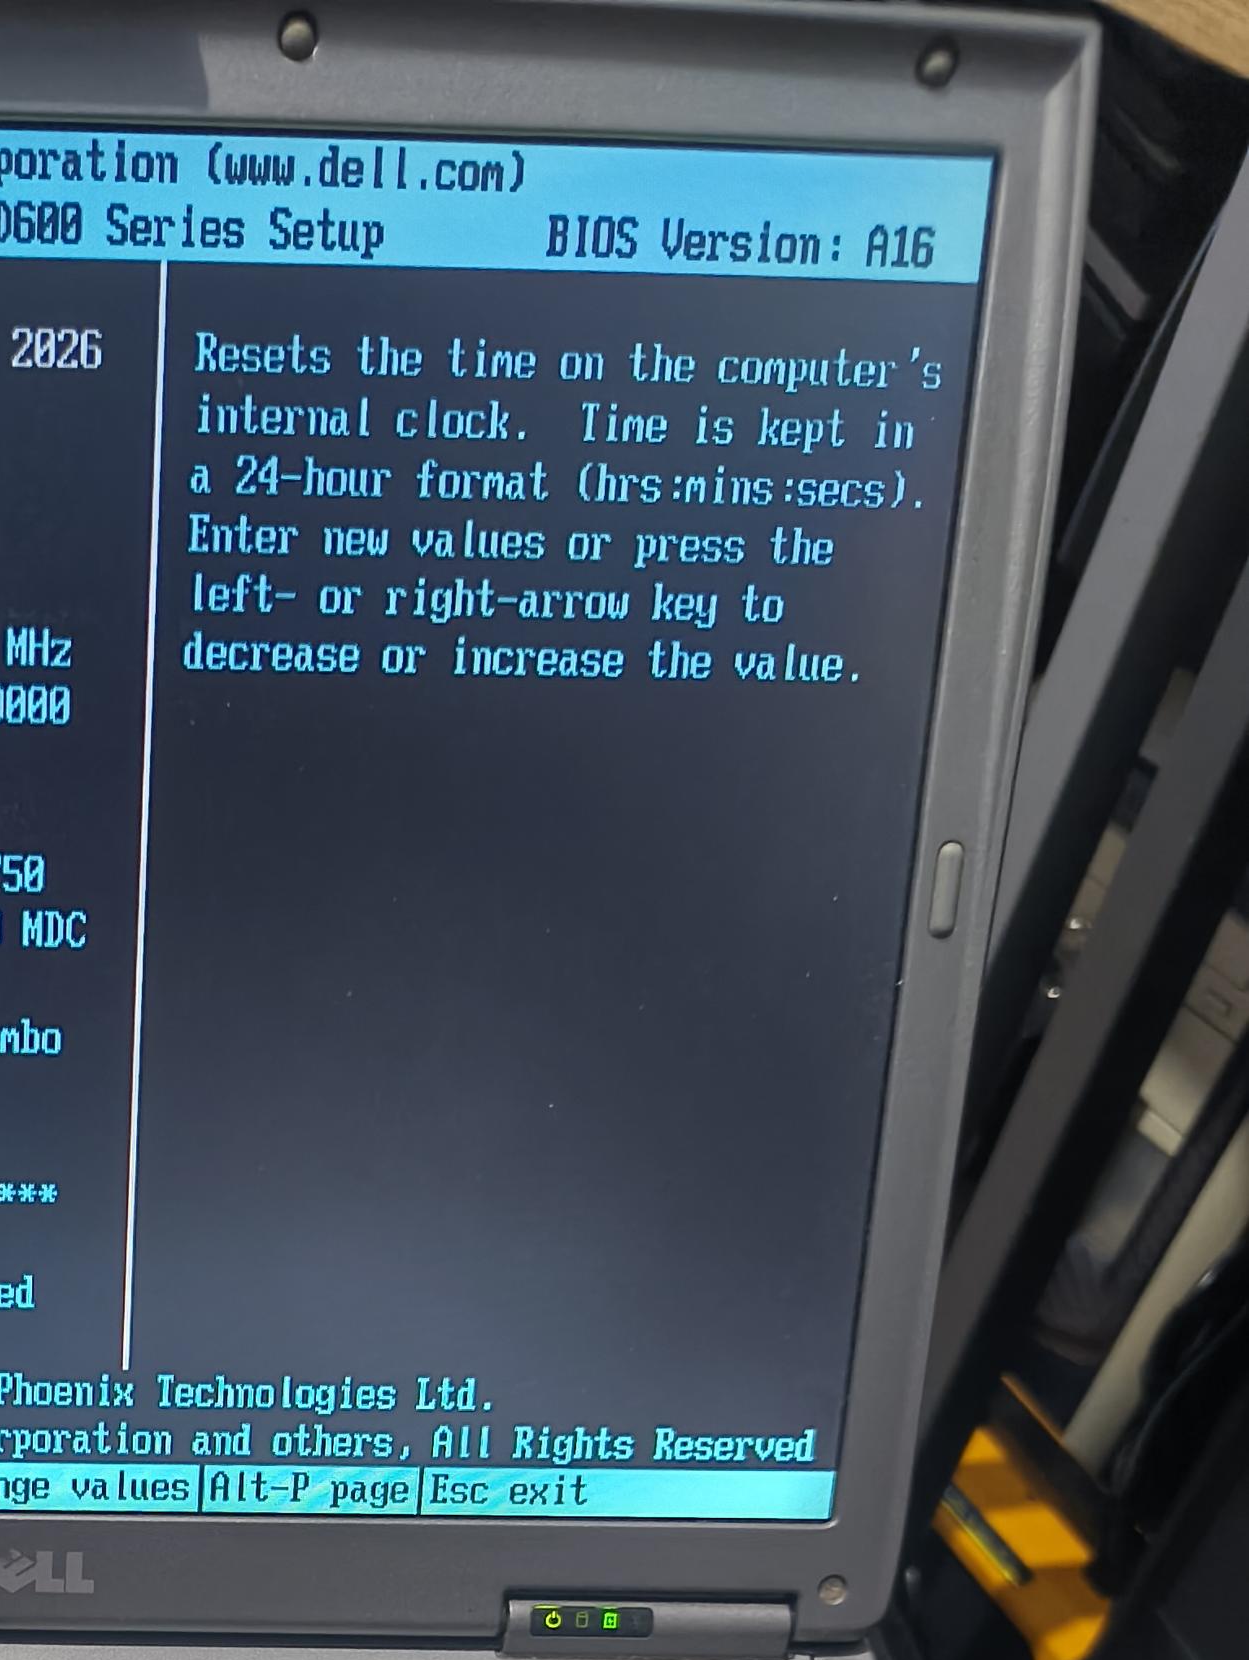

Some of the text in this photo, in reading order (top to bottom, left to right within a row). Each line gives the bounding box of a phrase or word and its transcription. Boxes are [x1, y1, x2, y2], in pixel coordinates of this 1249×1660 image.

[208, 142, 524, 192] (www.dell.com)
[107, 203, 244, 248] Series
[270, 207, 383, 259] Setup
[546, 215, 935, 268] BIOS Version: A16
[12, 328, 102, 368] 2026
[195, 332, 941, 392] Resets the time on the computer's
[198, 394, 913, 453] internal clock. Time is kept in
[191, 455, 921, 508] a 24-hour format (hrs:mins:secs).
[189, 514, 833, 568] Enter new values or press the
[7, 628, 71, 666] MHz
[23, 911, 86, 947] MDC
[158, 1375, 396, 1414] Technologies
[416, 1378, 490, 1410] Ltd.
[72, 1470, 189, 1500] values
[210, 1471, 408, 1508] Alt-P page
[430, 1474, 587, 1505] Esc exit
